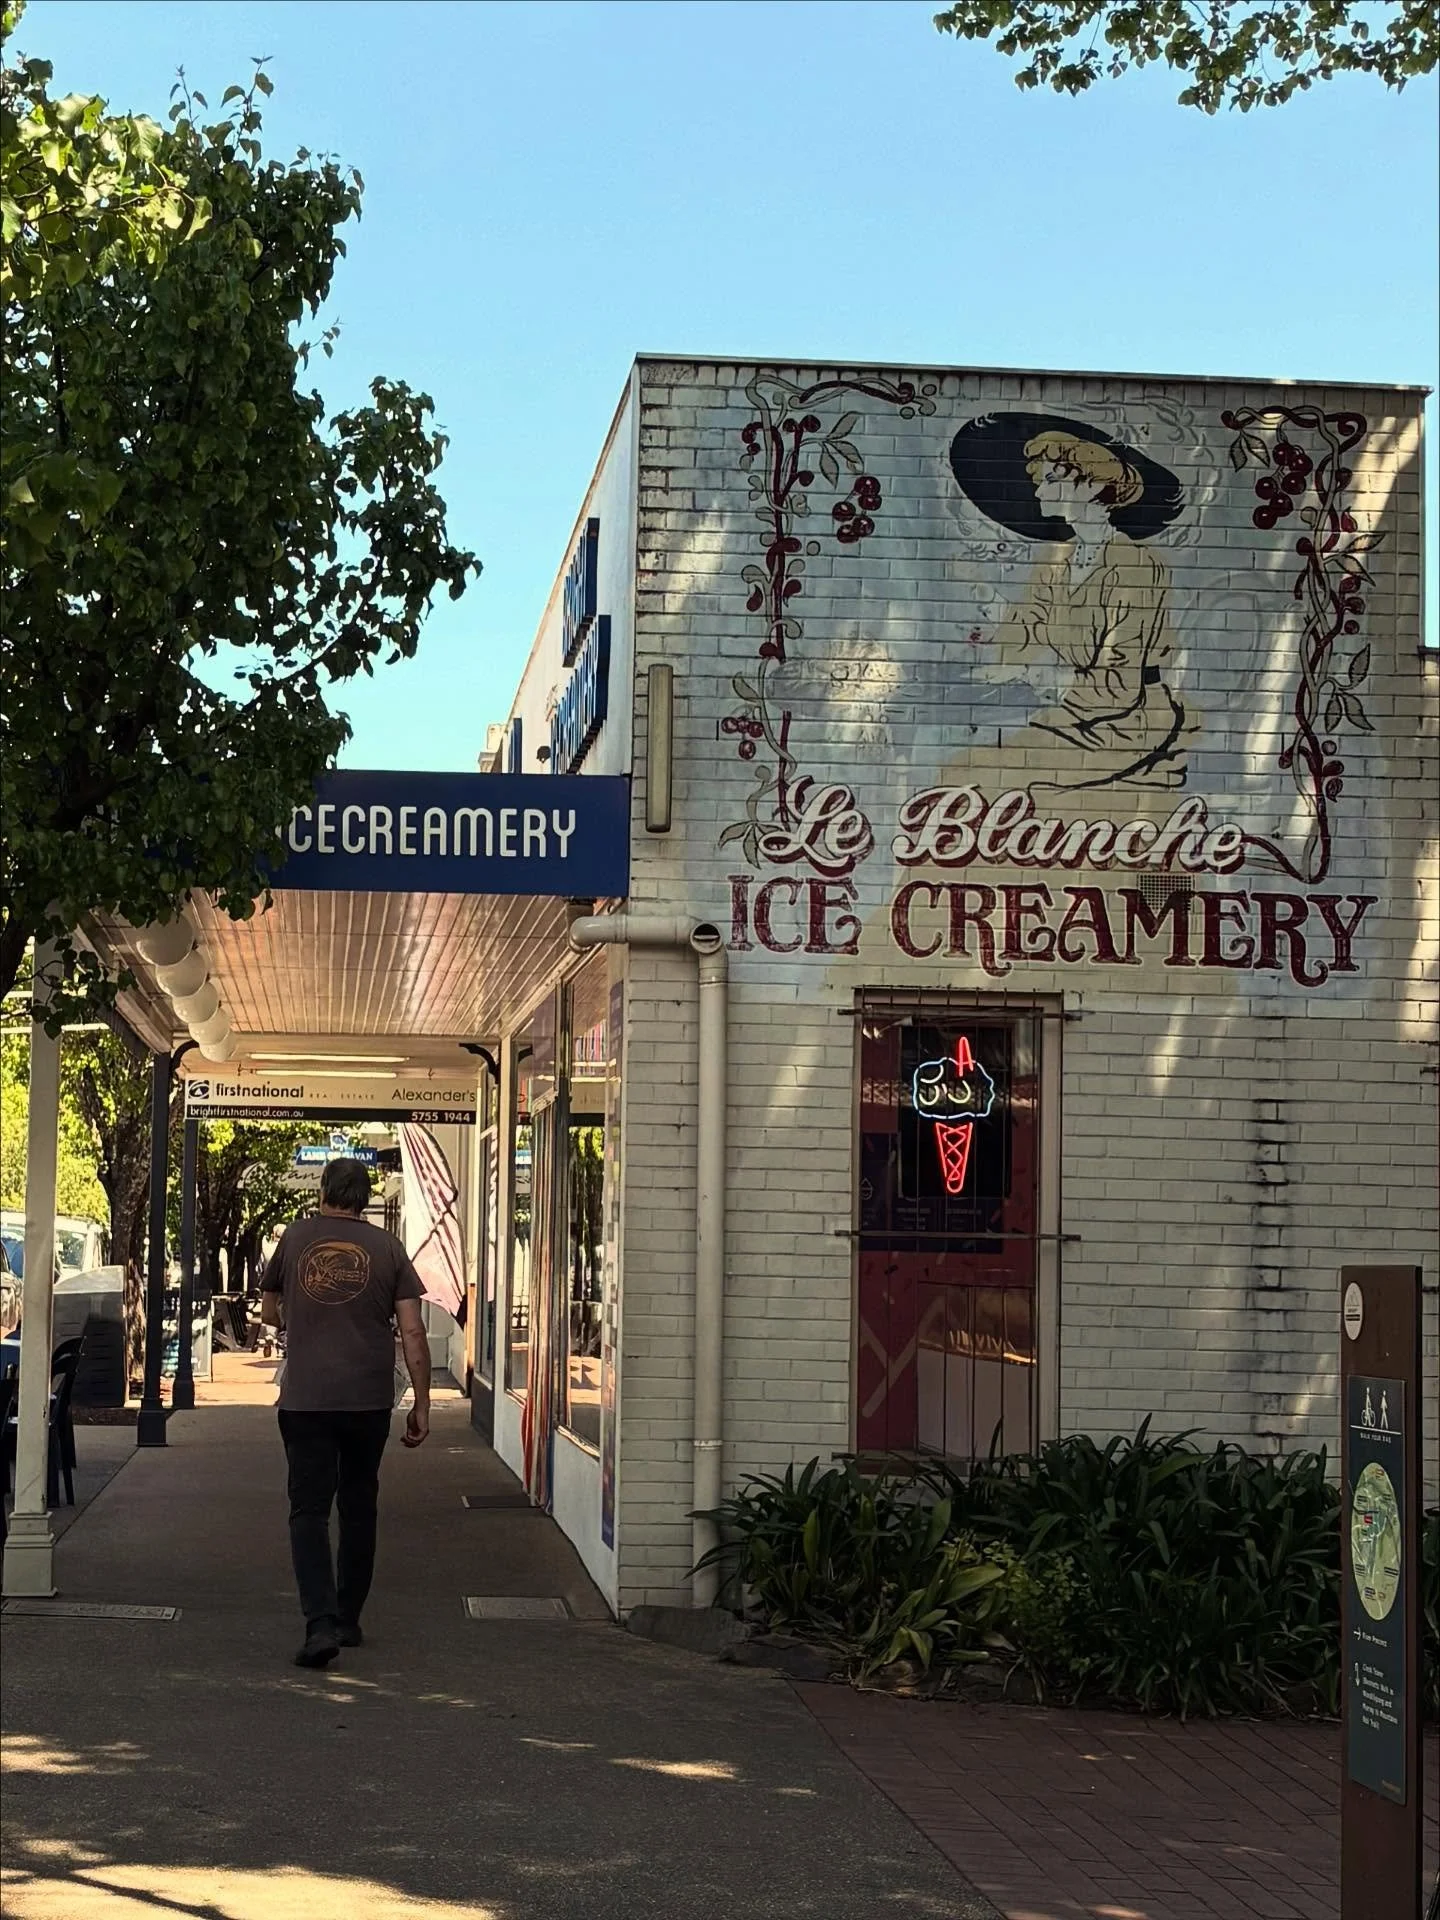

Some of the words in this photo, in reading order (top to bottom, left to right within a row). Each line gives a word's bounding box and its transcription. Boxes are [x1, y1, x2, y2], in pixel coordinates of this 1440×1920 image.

[276, 804, 576, 858] CECREAMERY
[757, 775, 874, 875] Le
[892, 784, 1248, 874] Blanche
[727, 874, 860, 956] ICE
[892, 881, 1379, 987] CREAMERY
[190, 1105, 304, 1119] brightfirstnational.com.au
[411, 1111, 439, 1122] 5755
[444, 1112, 471, 1123] 1944
[215, 1080, 304, 1099] firstnational
[392, 1087, 476, 1102] Alexander's
